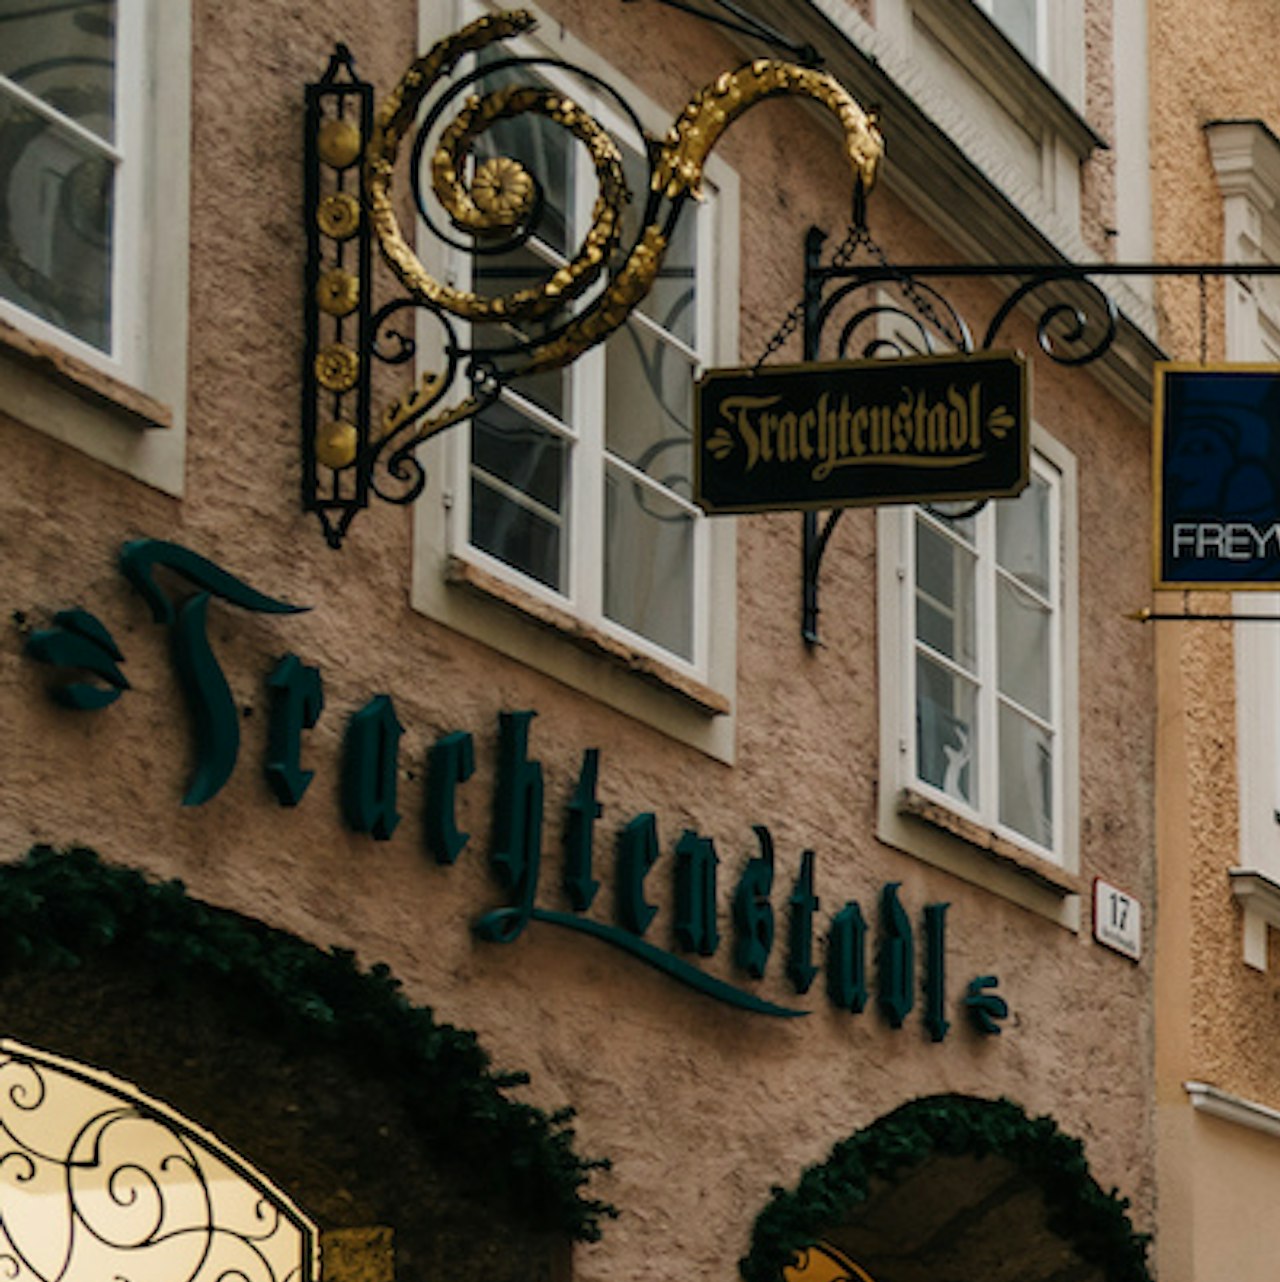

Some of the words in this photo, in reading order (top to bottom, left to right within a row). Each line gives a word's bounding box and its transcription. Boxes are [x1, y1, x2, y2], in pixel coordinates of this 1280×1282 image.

[718, 382, 985, 481] Trachtenstadl
[117, 536, 952, 1042] Trachtenstadl
[1109, 892, 1131, 931] 17
